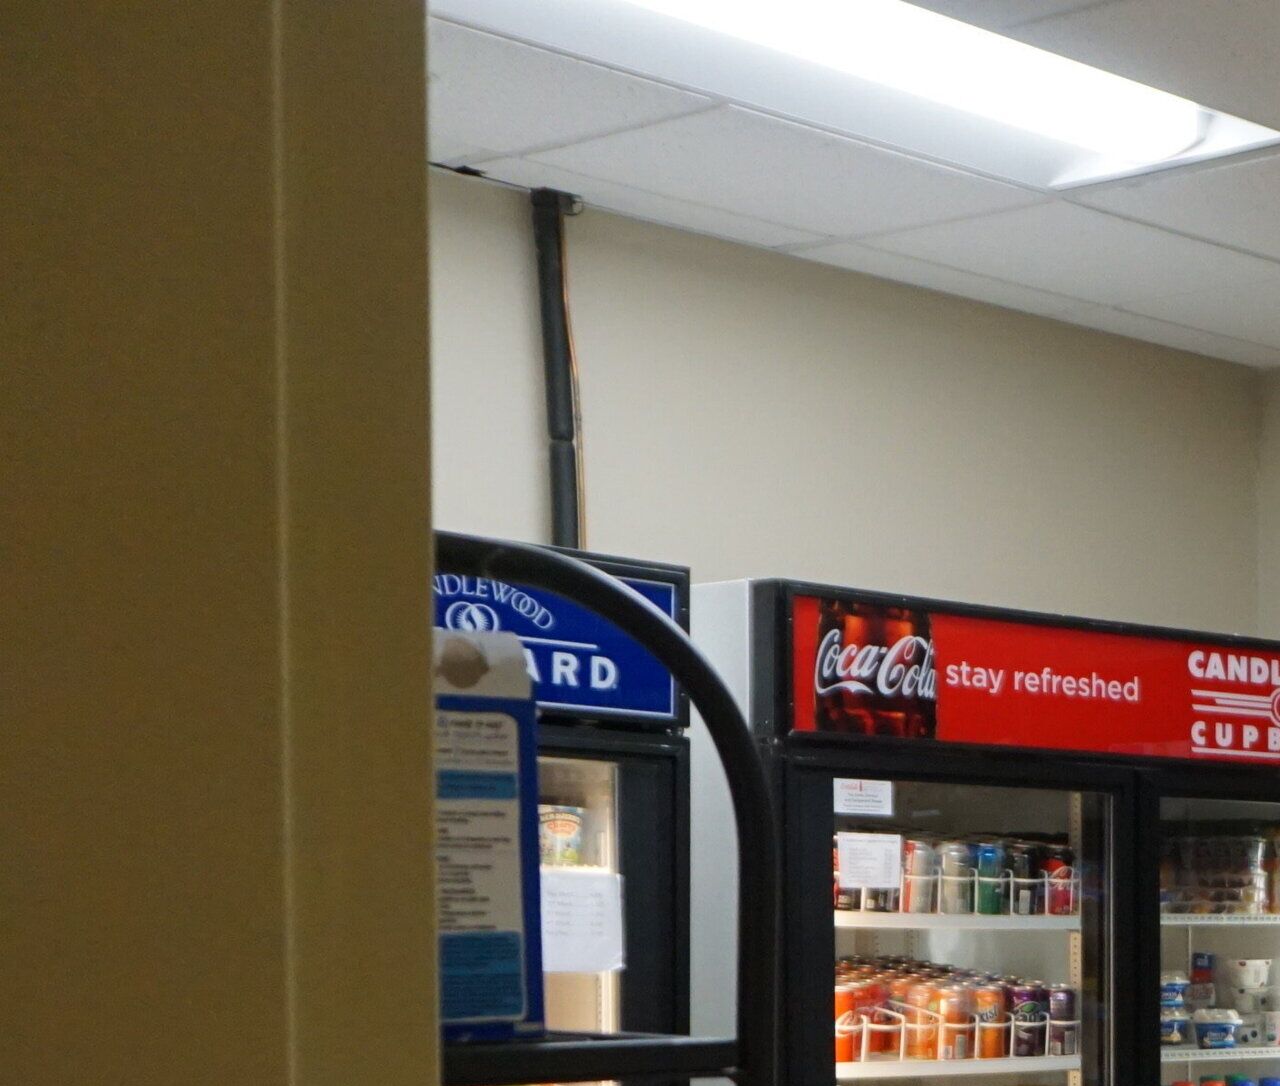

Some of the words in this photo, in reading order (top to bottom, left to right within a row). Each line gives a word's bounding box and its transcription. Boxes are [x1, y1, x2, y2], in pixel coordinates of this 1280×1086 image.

[815, 627, 936, 699] Coca-Cola
[945, 660, 1004, 694] stay
[1013, 670, 1140, 703] refreshed
